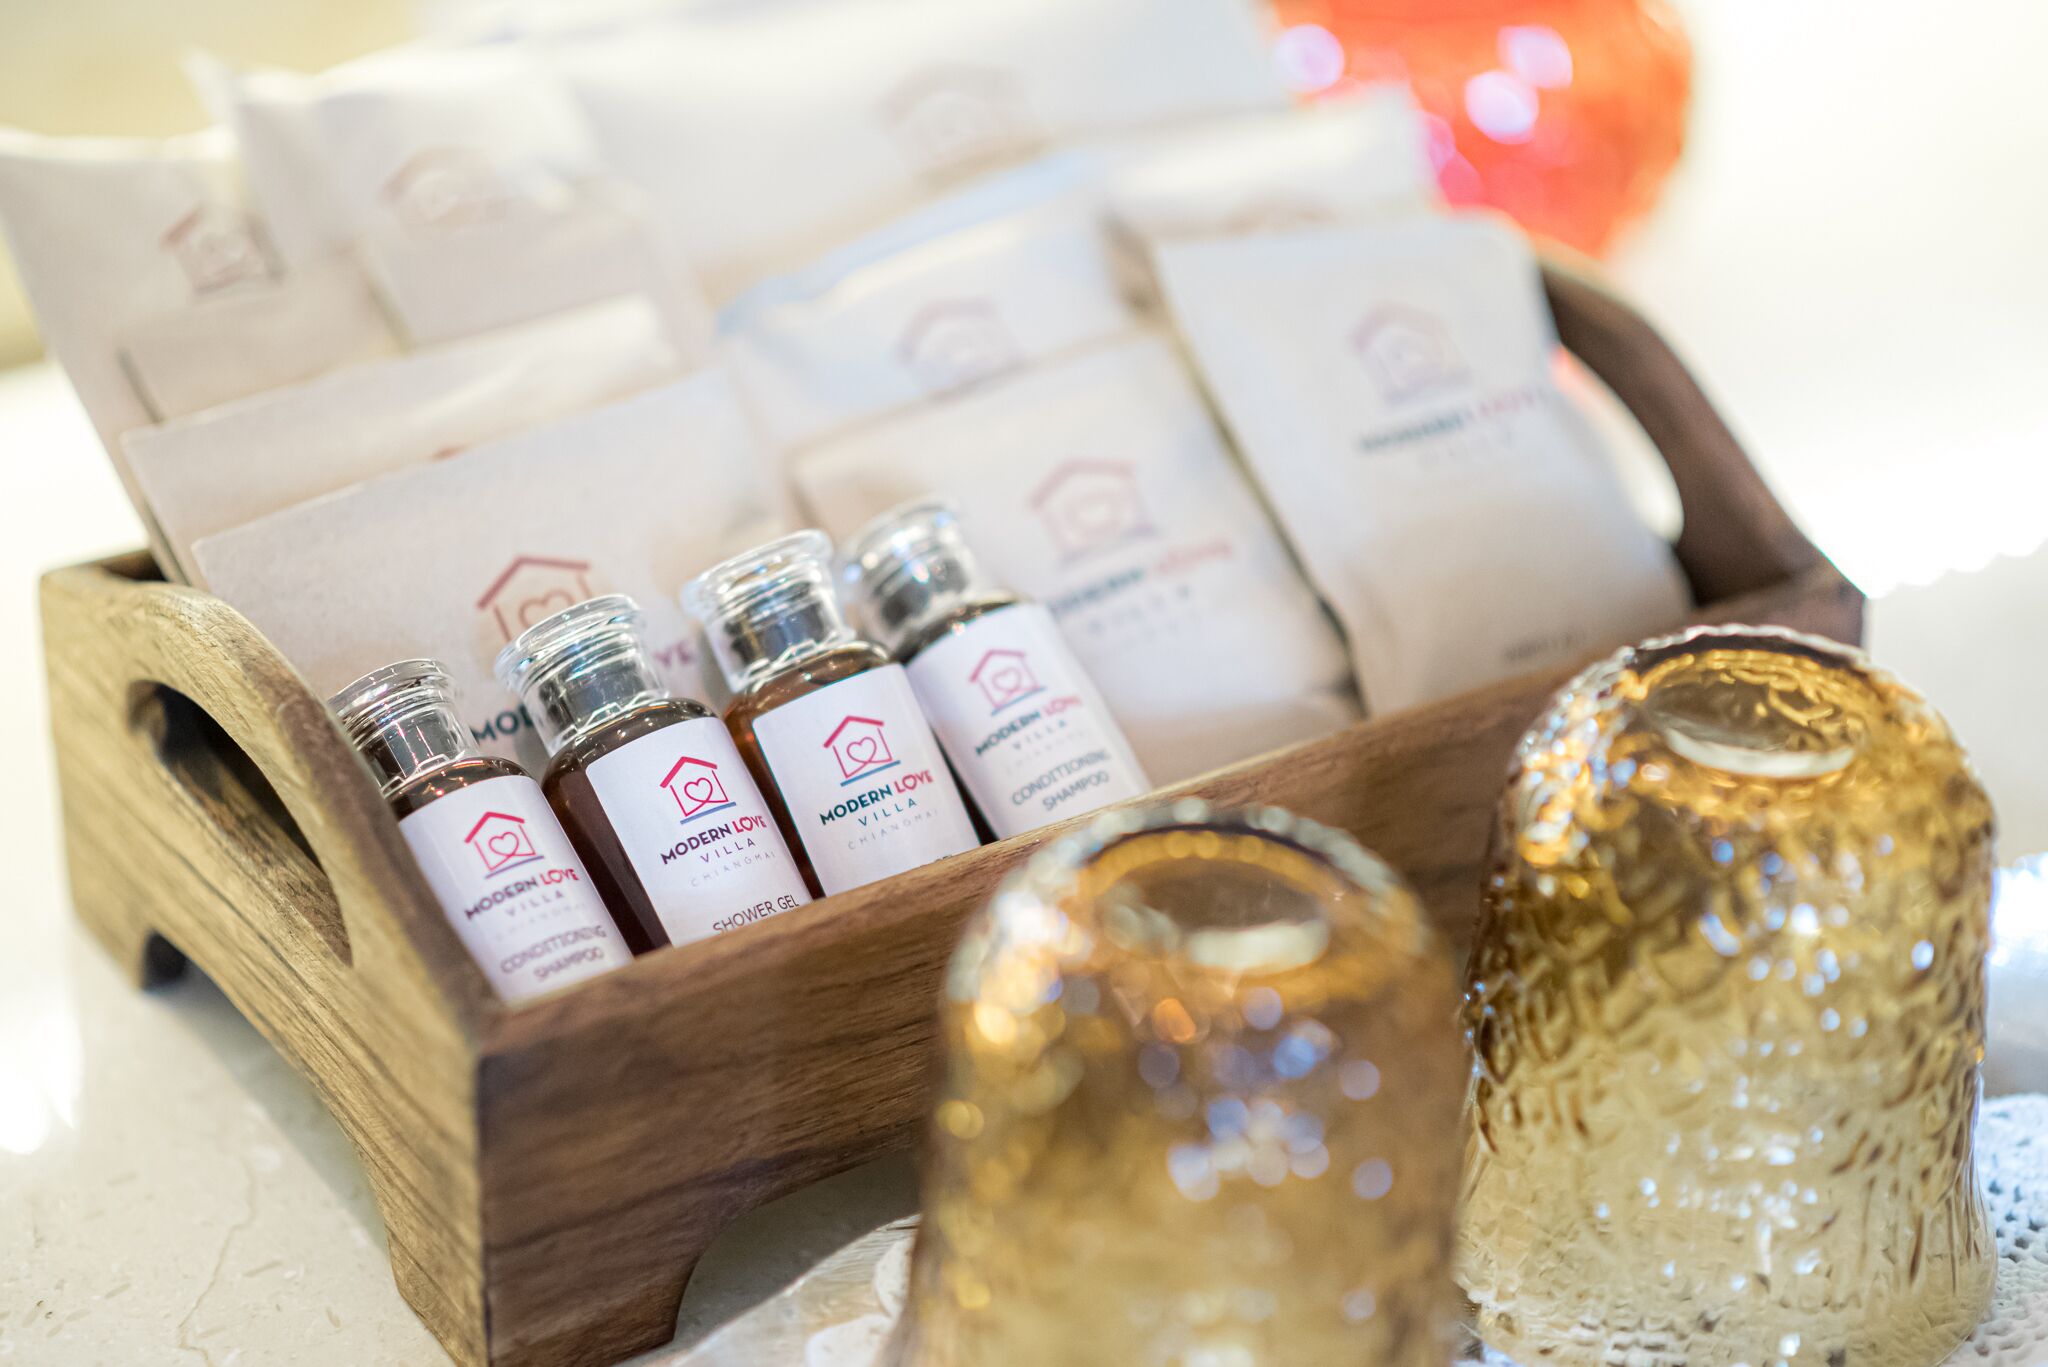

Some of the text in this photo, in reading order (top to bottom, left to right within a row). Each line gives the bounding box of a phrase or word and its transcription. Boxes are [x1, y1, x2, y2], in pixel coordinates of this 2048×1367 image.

[975, 710, 1041, 756] MODERN
[1011, 748, 1112, 805] CONDITIONING
[1042, 770, 1109, 812] SHAMPOO
[819, 770, 933, 826] MODERN LOVE
[858, 798, 917, 826] VILLA
[660, 815, 767, 865] MODERN LOVE
[700, 837, 756, 864] VILLA
[691, 851, 776, 888] CHIANGMAI
[464, 868, 580, 921] MODERN LOVE
[506, 890, 564, 917] VILLA
[712, 894, 800, 934] SHOWER GEL
[501, 925, 607, 974] CONDITIONING
[534, 946, 605, 980] SHAMPOO
